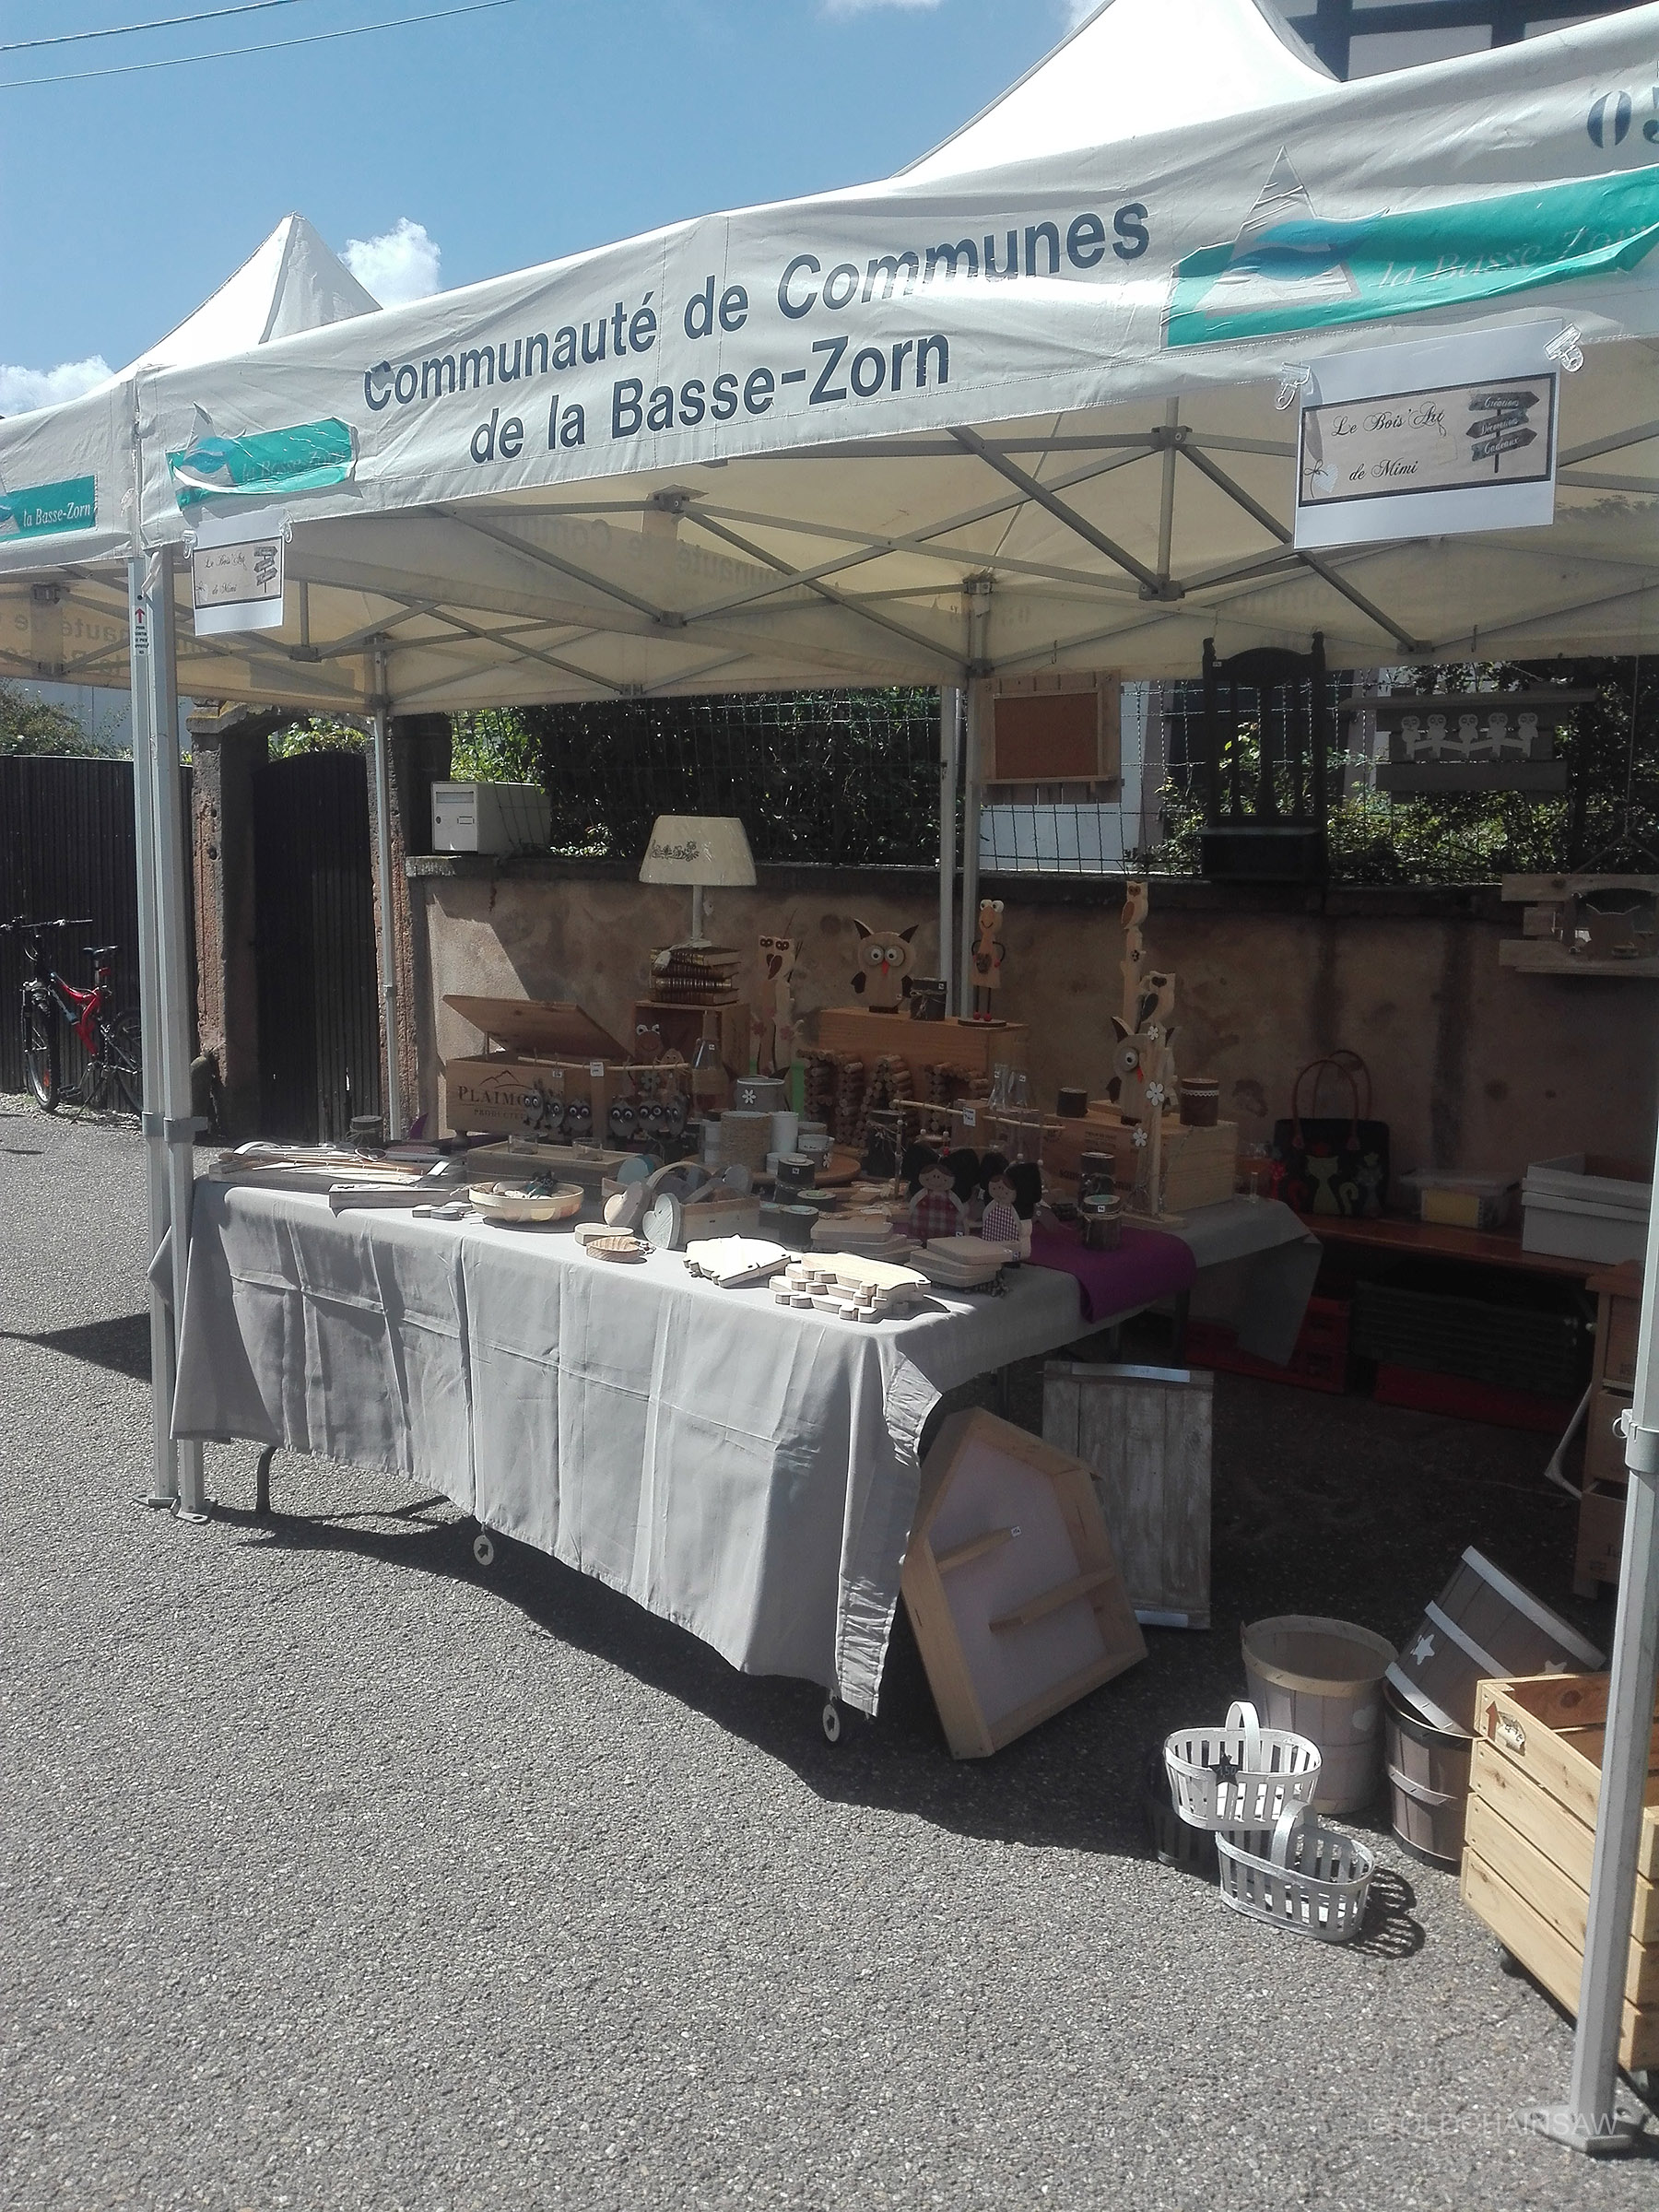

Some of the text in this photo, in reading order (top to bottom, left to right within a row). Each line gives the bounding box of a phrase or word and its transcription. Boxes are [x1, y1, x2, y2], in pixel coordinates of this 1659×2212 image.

[364, 202, 1150, 411] Communauté de Communes
[469, 333, 950, 464] de la Basse-Zorn
[1331, 415, 1358, 437] Le
[1484, 436, 1520, 454] Cadeaux
[1348, 458, 1419, 482] de Mimi
[23, 501, 90, 527] la Basse-Zorn
